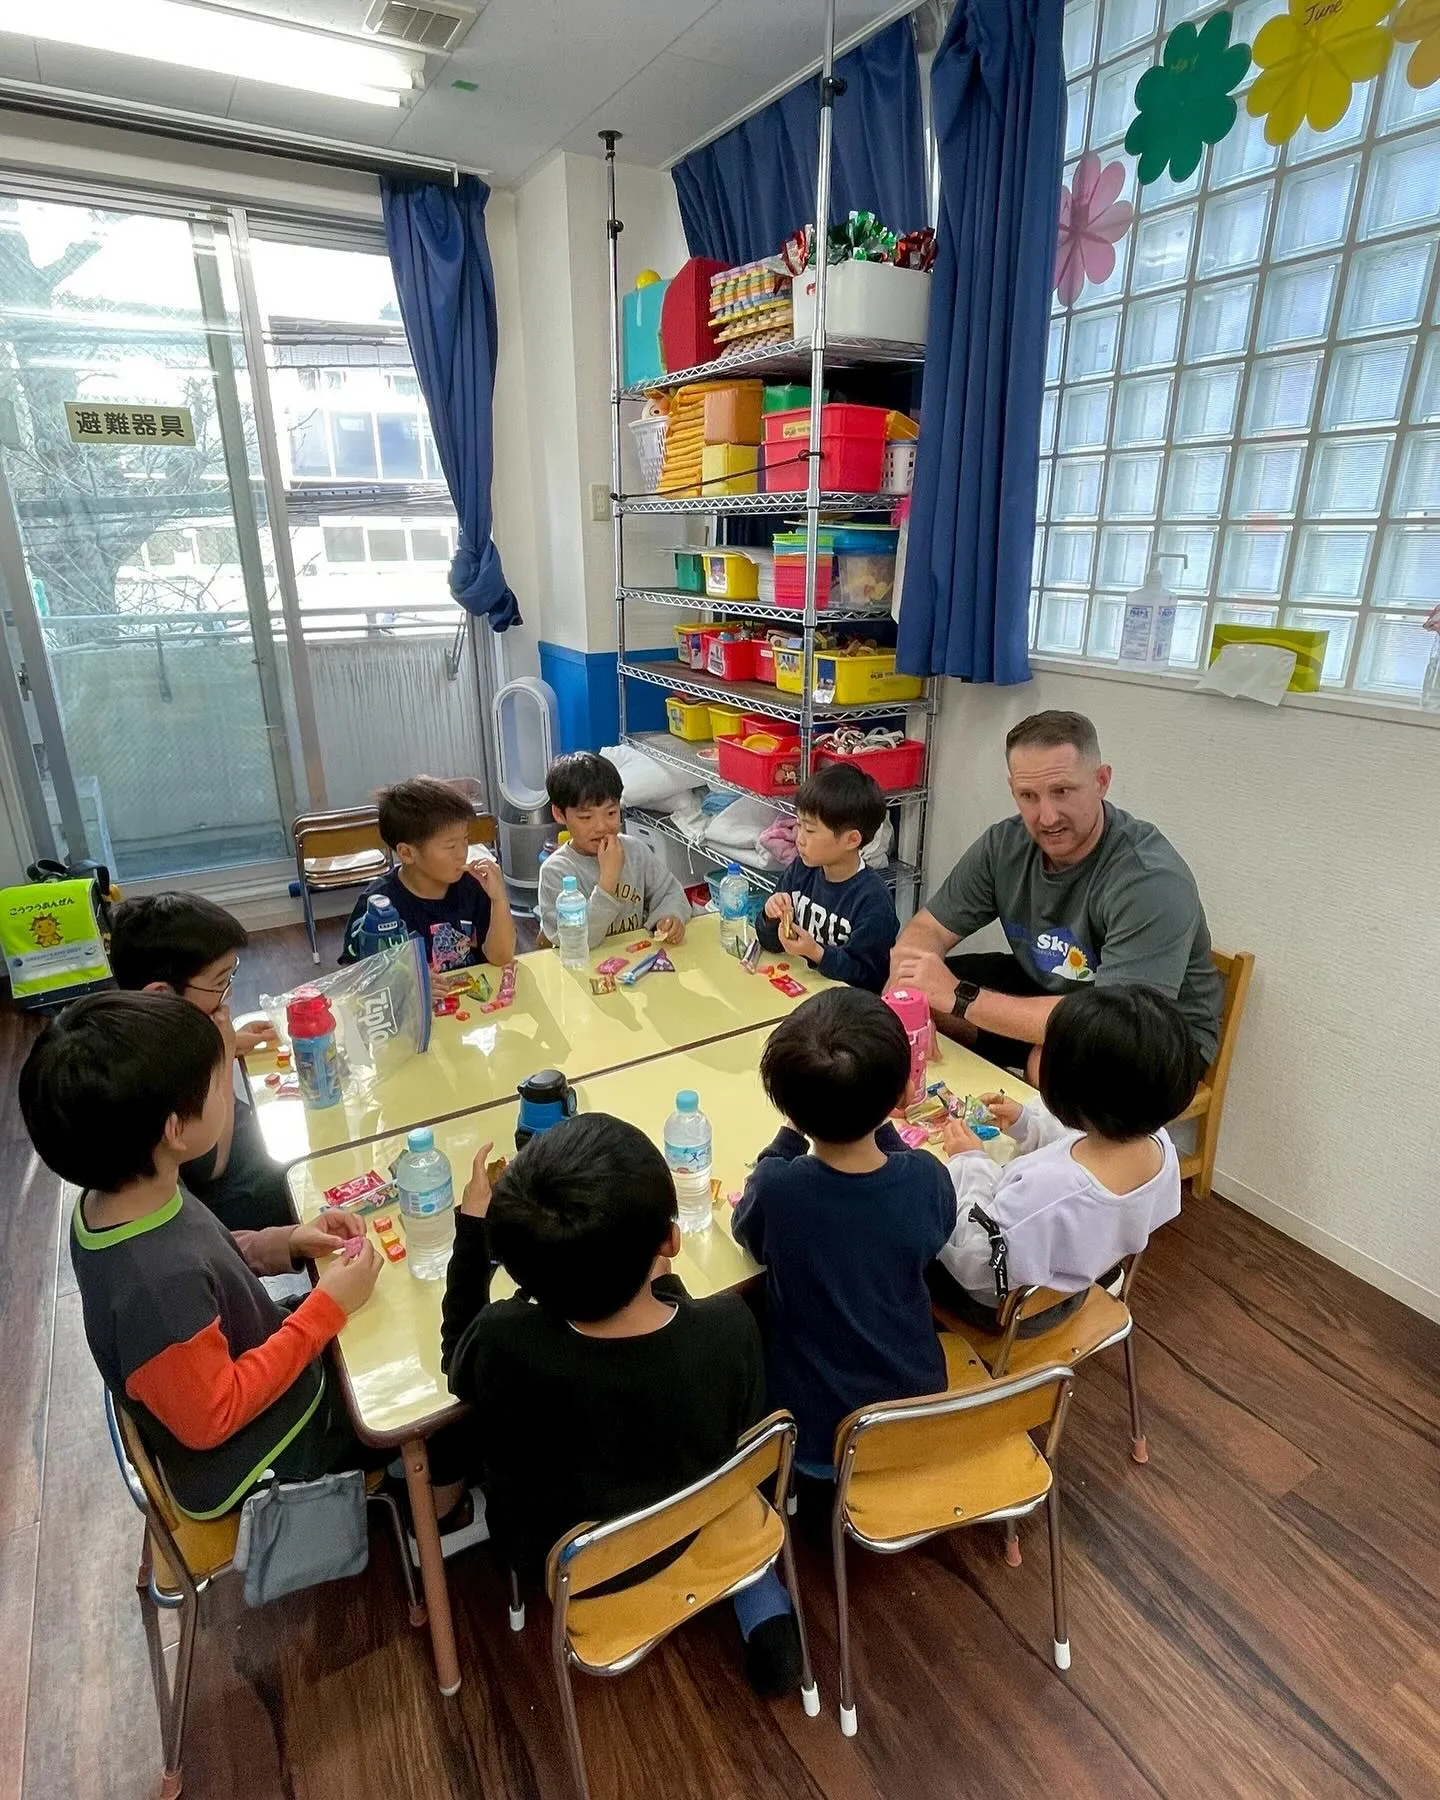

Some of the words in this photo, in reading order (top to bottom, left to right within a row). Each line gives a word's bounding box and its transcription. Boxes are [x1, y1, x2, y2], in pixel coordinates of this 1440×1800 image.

[1304, 1, 1343, 25] June
[75, 411, 185, 437] 避難器具
[1036, 933, 1069, 957] Sky
